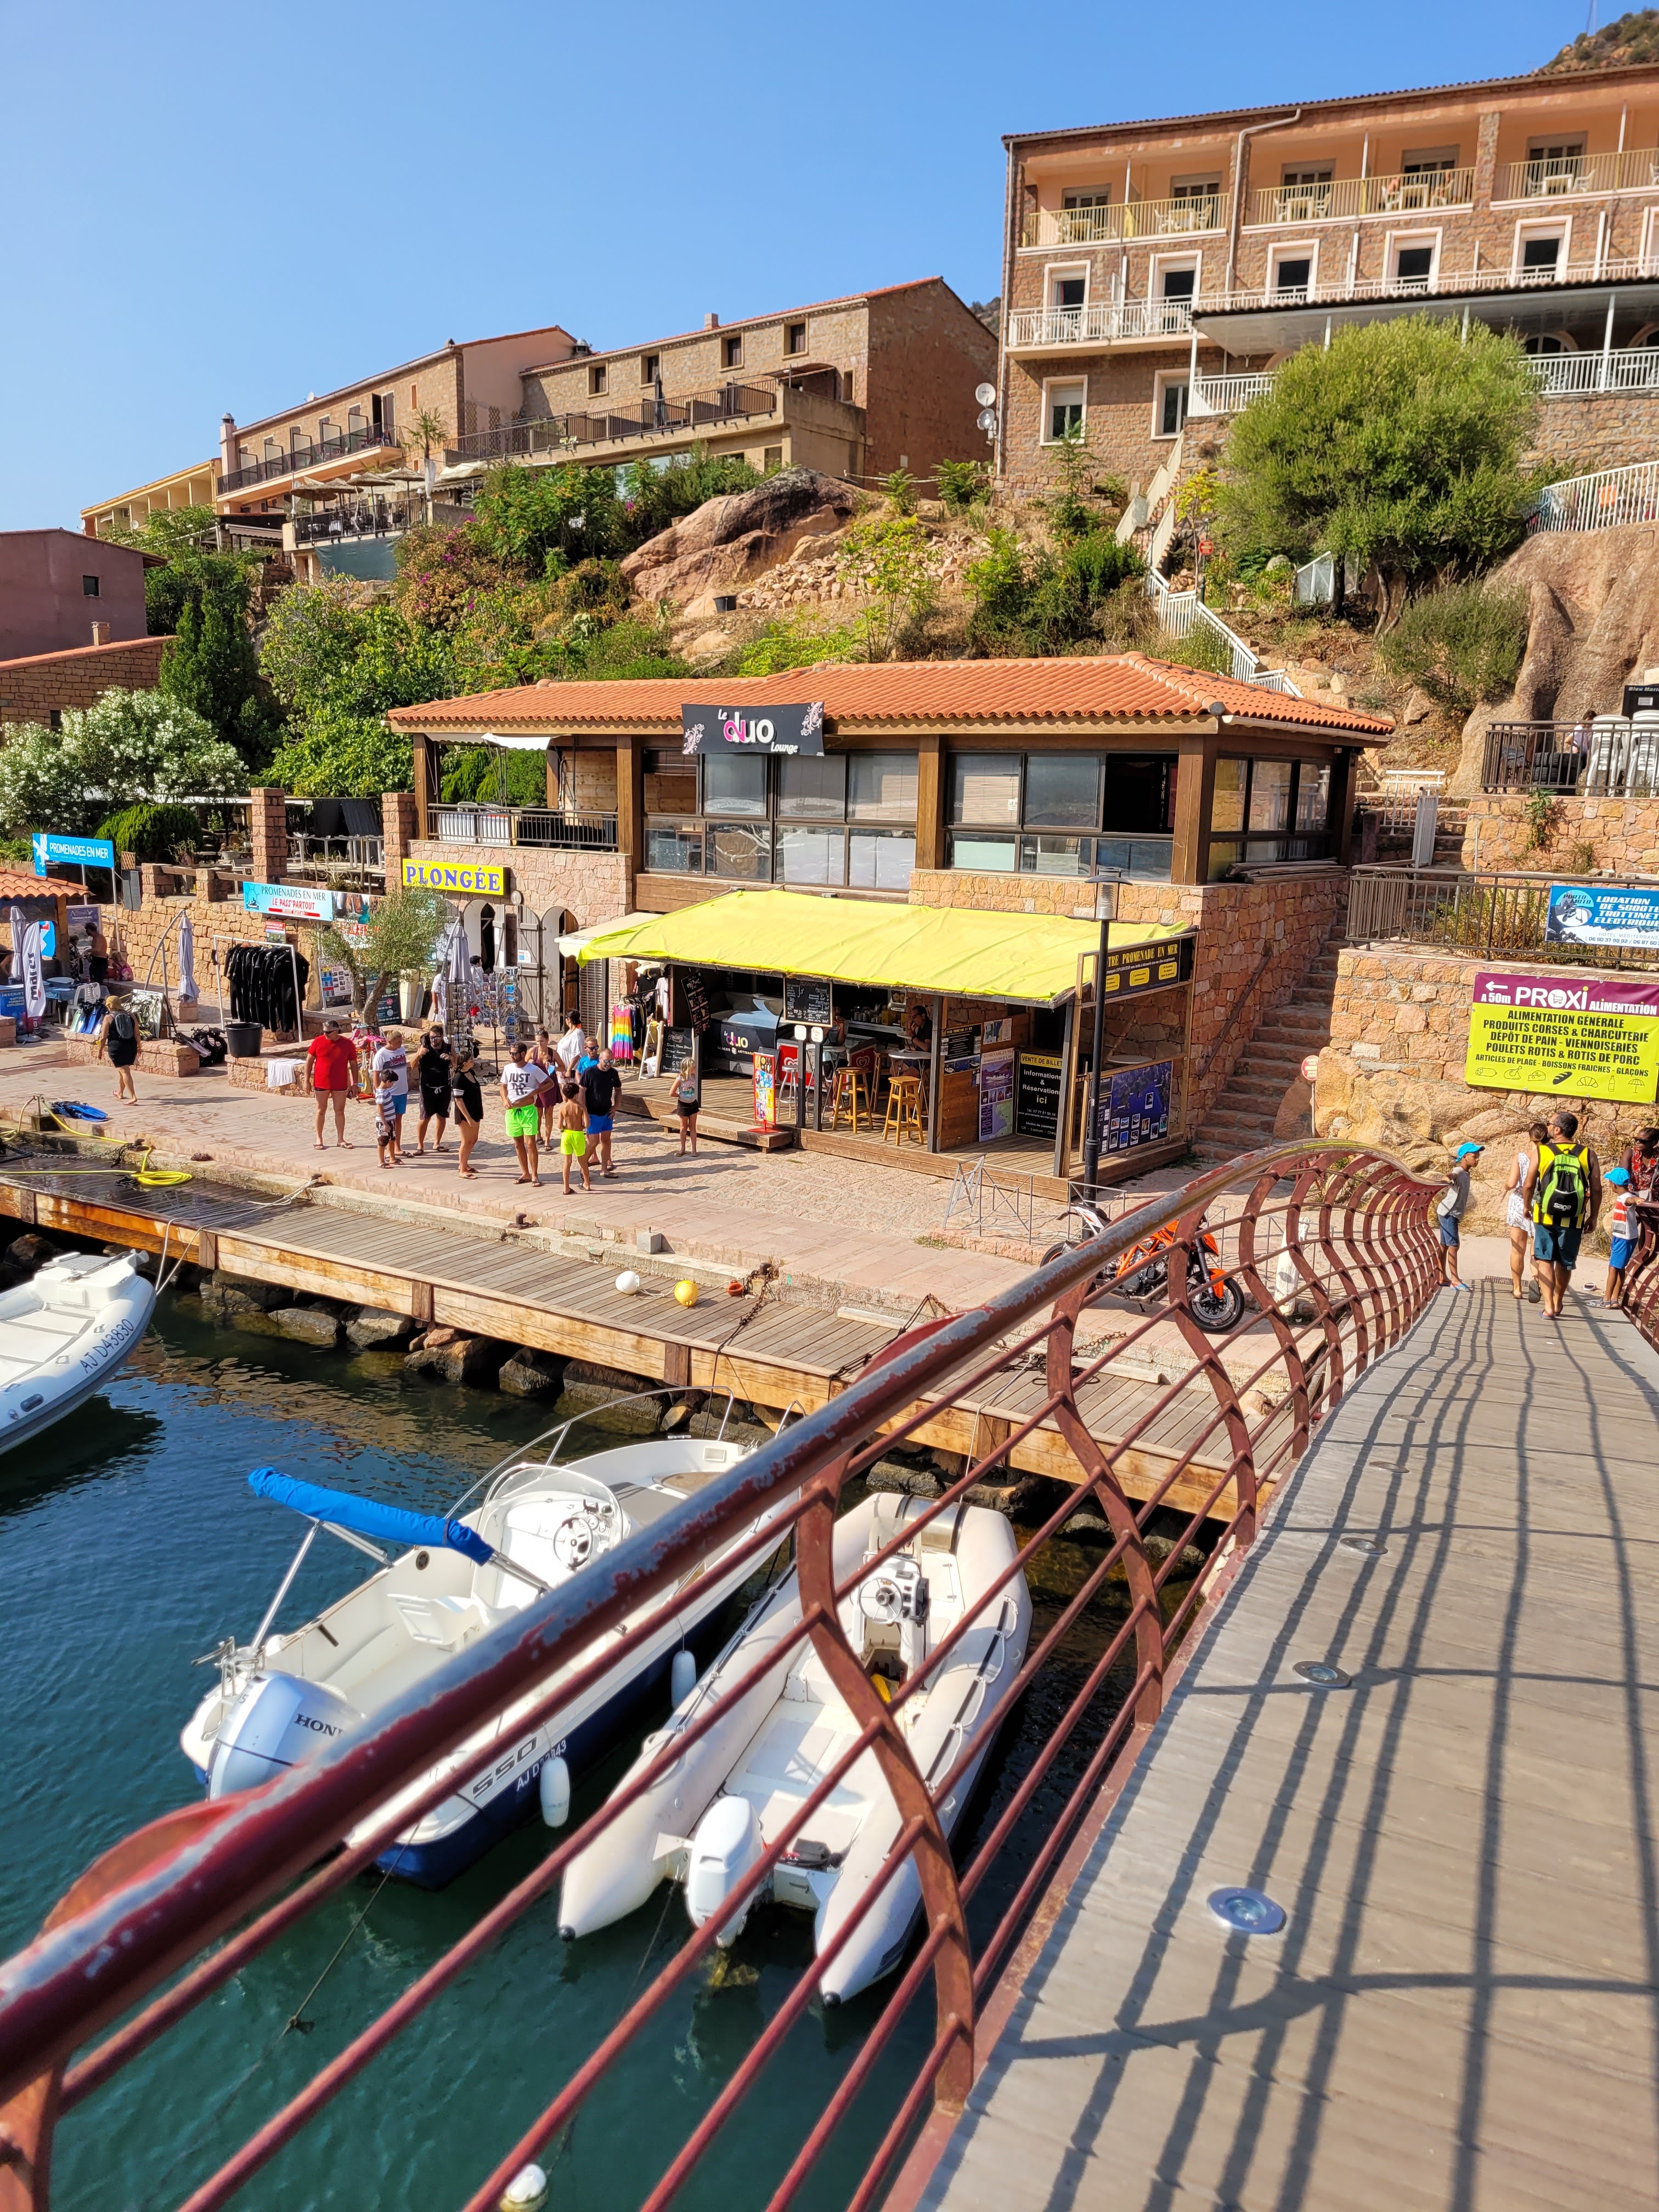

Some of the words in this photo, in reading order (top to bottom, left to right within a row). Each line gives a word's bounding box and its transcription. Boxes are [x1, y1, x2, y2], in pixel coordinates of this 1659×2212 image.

[718, 709, 727, 720] Le
[723, 712, 775, 743] duo
[770, 742, 798, 754] Lounge
[49, 843, 86, 857] PROMENADES
[87, 847, 95, 857] EN
[95, 847, 109, 859] MER
[405, 866, 500, 891] PLONGÉE
[261, 886, 301, 898] PROMENADES
[313, 892, 326, 901] MER
[1596, 895, 1651, 905] LOCATION
[272, 898, 278, 906] LE
[1108, 955, 1119, 967] TRE
[1122, 947, 1155, 964] PROMENADE
[1158, 946, 1165, 957] EN
[1167, 944, 1178, 956] MER
[1481, 994, 1487, 1002] A
[1488, 992, 1511, 1004] 50m
[1507, 1010, 1575, 1025] ALIMENTATION
[1577, 1014, 1624, 1028] GÉNÉRALE
[1483, 1019, 1530, 1032] PRODUITS
[1532, 1024, 1569, 1036] CORSES
[1581, 1029, 1649, 1042] CHARCUTERIE
[726, 1031, 748, 1048] duo
[1490, 1030, 1520, 1042] DÉPÔT
[1522, 1034, 1533, 1043] DE
[1536, 1036, 1557, 1046] PAIN
[1565, 1037, 1638, 1053] VIENNOISERIES
[1486, 1042, 1525, 1054] POULETS
[1528, 1047, 1556, 1058] ROTIS
[1558, 1050, 1565, 1059] &
[1567, 1051, 1596, 1062] ROTIS
[1599, 1053, 1611, 1063] DE
[1613, 1055, 1640, 1065] PORC
[1475, 1054, 1506, 1063] ARTICLES
[1516, 1058, 1537, 1066] PLAGE
[1542, 1060, 1576, 1070] BOISSONS
[1578, 1064, 1611, 1073] FRAICHES
[1616, 1068, 1649, 1077] GLAÇONS
[509, 1073, 530, 1083] JUST
[1024, 1069, 1062, 1080] Informations
[1036, 1095, 1047, 1104] ici
[1553, 1203, 1571, 1211] sage
[80, 1352, 98, 1374] AJ
[92, 1319, 134, 1357] D43830
[516, 1770, 529, 1792] AJ
